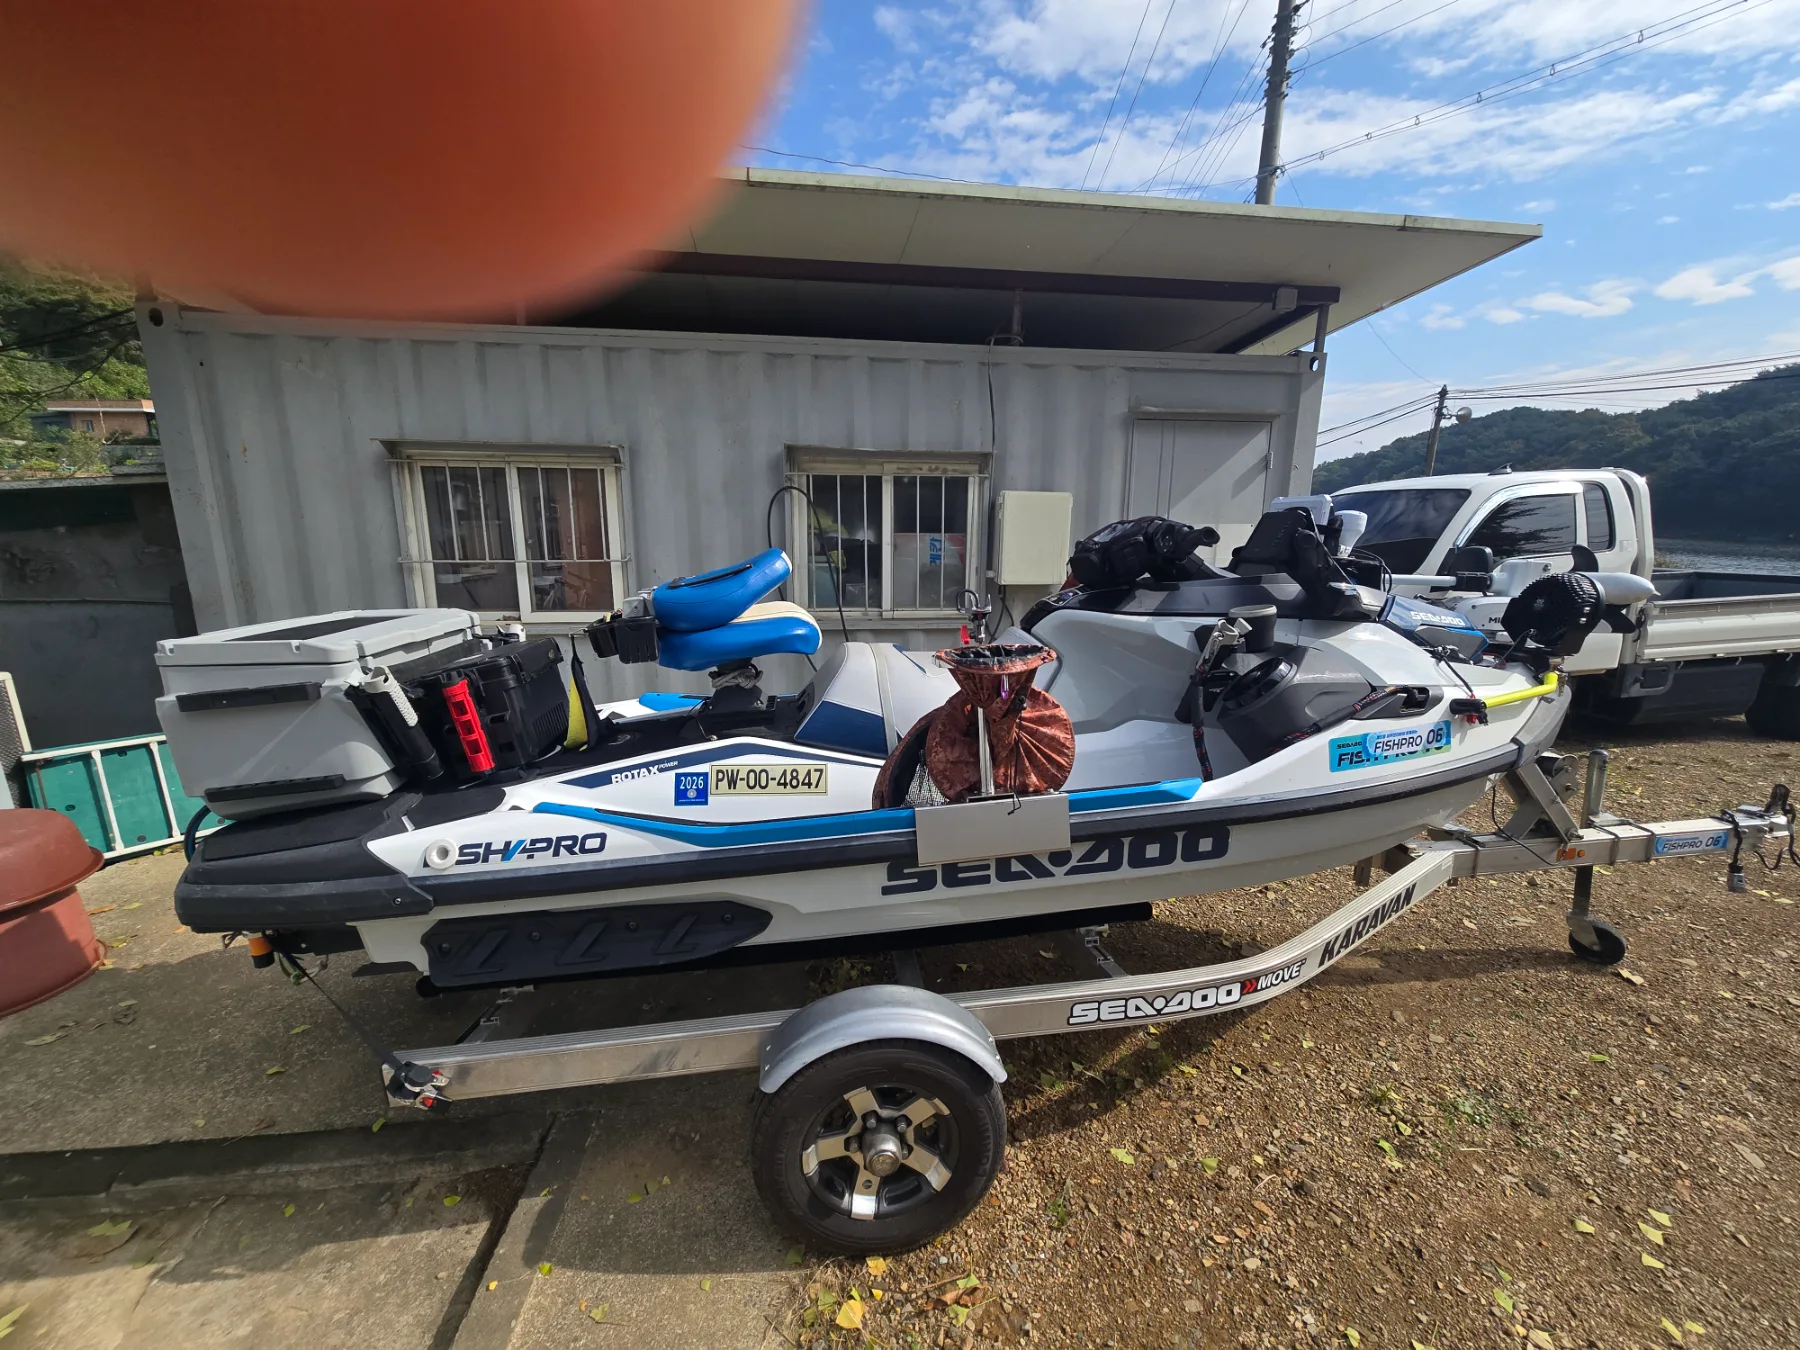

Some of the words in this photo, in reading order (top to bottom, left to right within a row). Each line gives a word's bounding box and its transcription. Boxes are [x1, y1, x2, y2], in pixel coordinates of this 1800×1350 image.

[1374, 735, 1423, 753] FISHPRO
[1426, 727, 1444, 745] 06
[611, 766, 660, 785] ROTAX
[659, 760, 679, 769] POWER
[680, 776, 705, 790] 2026
[715, 768, 824, 791] PW-00-4847
[1662, 840, 1703, 852] FISHPRO
[1705, 835, 1723, 847] 06
[1317, 881, 1418, 968] KARAVAN
[1257, 965, 1302, 991] MOVE
